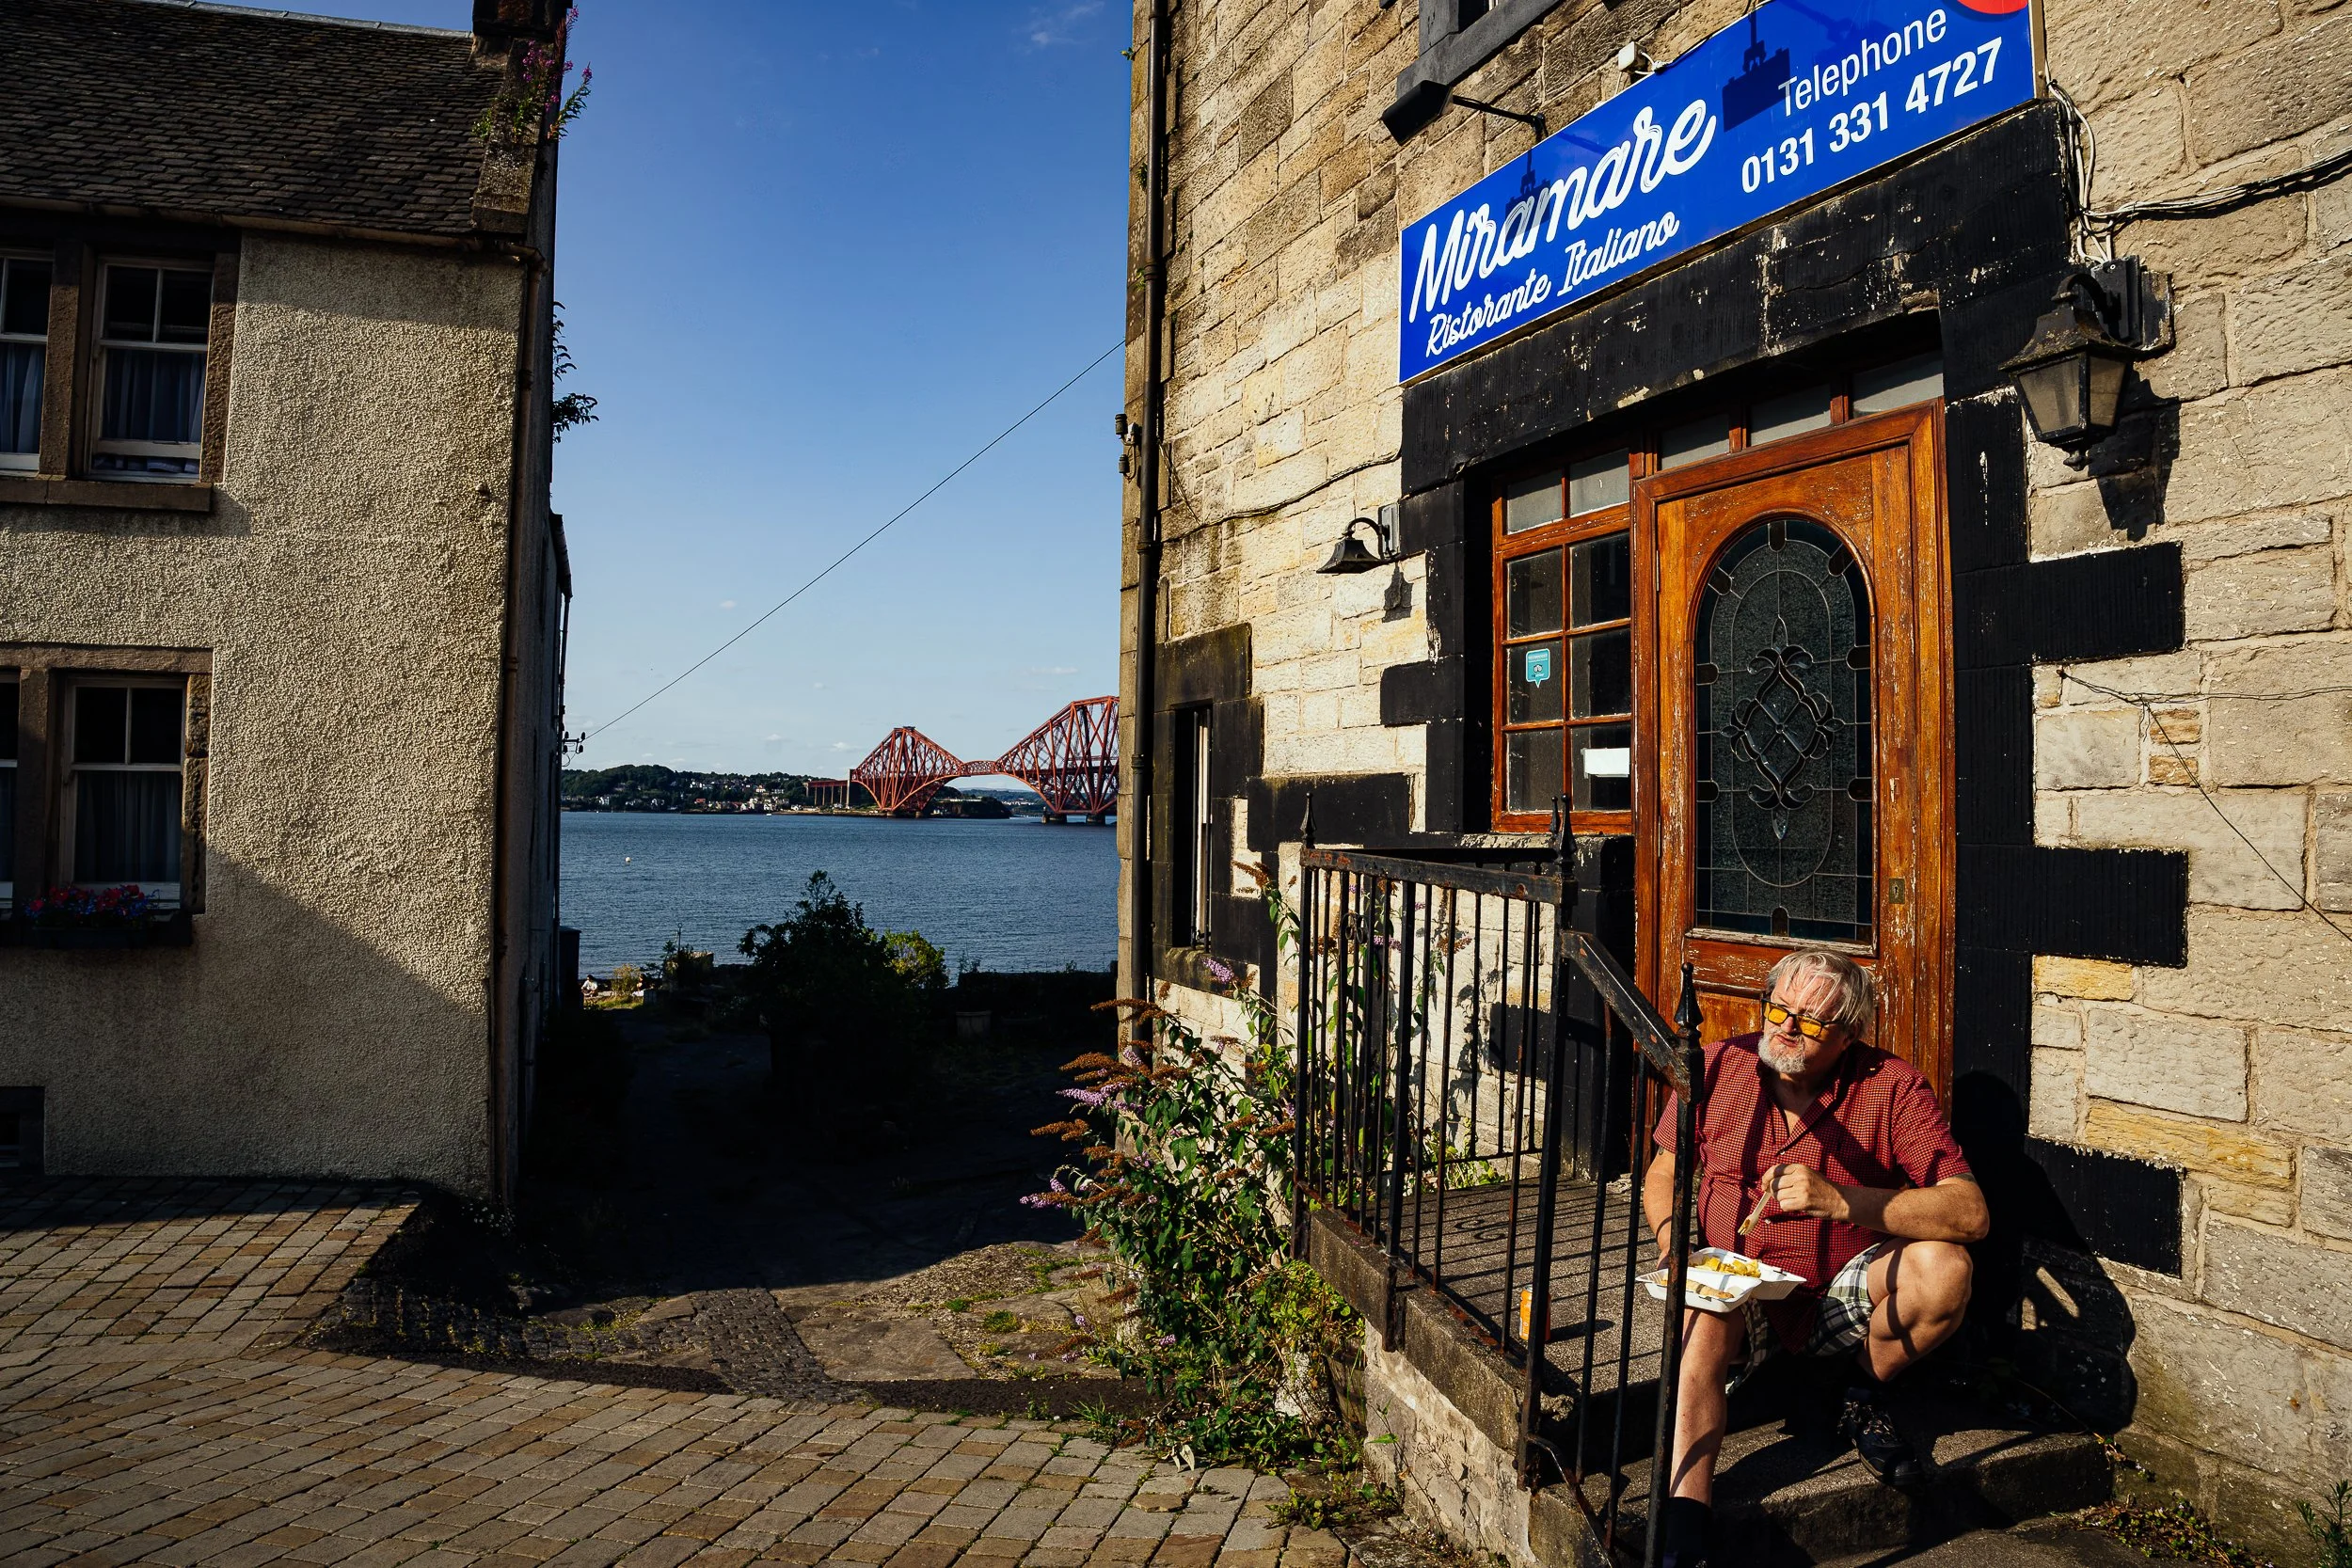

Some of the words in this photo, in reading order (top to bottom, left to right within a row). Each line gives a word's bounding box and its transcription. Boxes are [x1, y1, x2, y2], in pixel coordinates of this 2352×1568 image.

[1742, 128, 1814, 194] 0131
[1829, 91, 1888, 153] 331
[1905, 37, 2002, 113] 4727
[1777, 9, 1946, 118] Telephone
[1408, 99, 1716, 323] Miramare
[1425, 268, 1551, 358] Ristorante
[1557, 212, 1679, 296] Italiano
